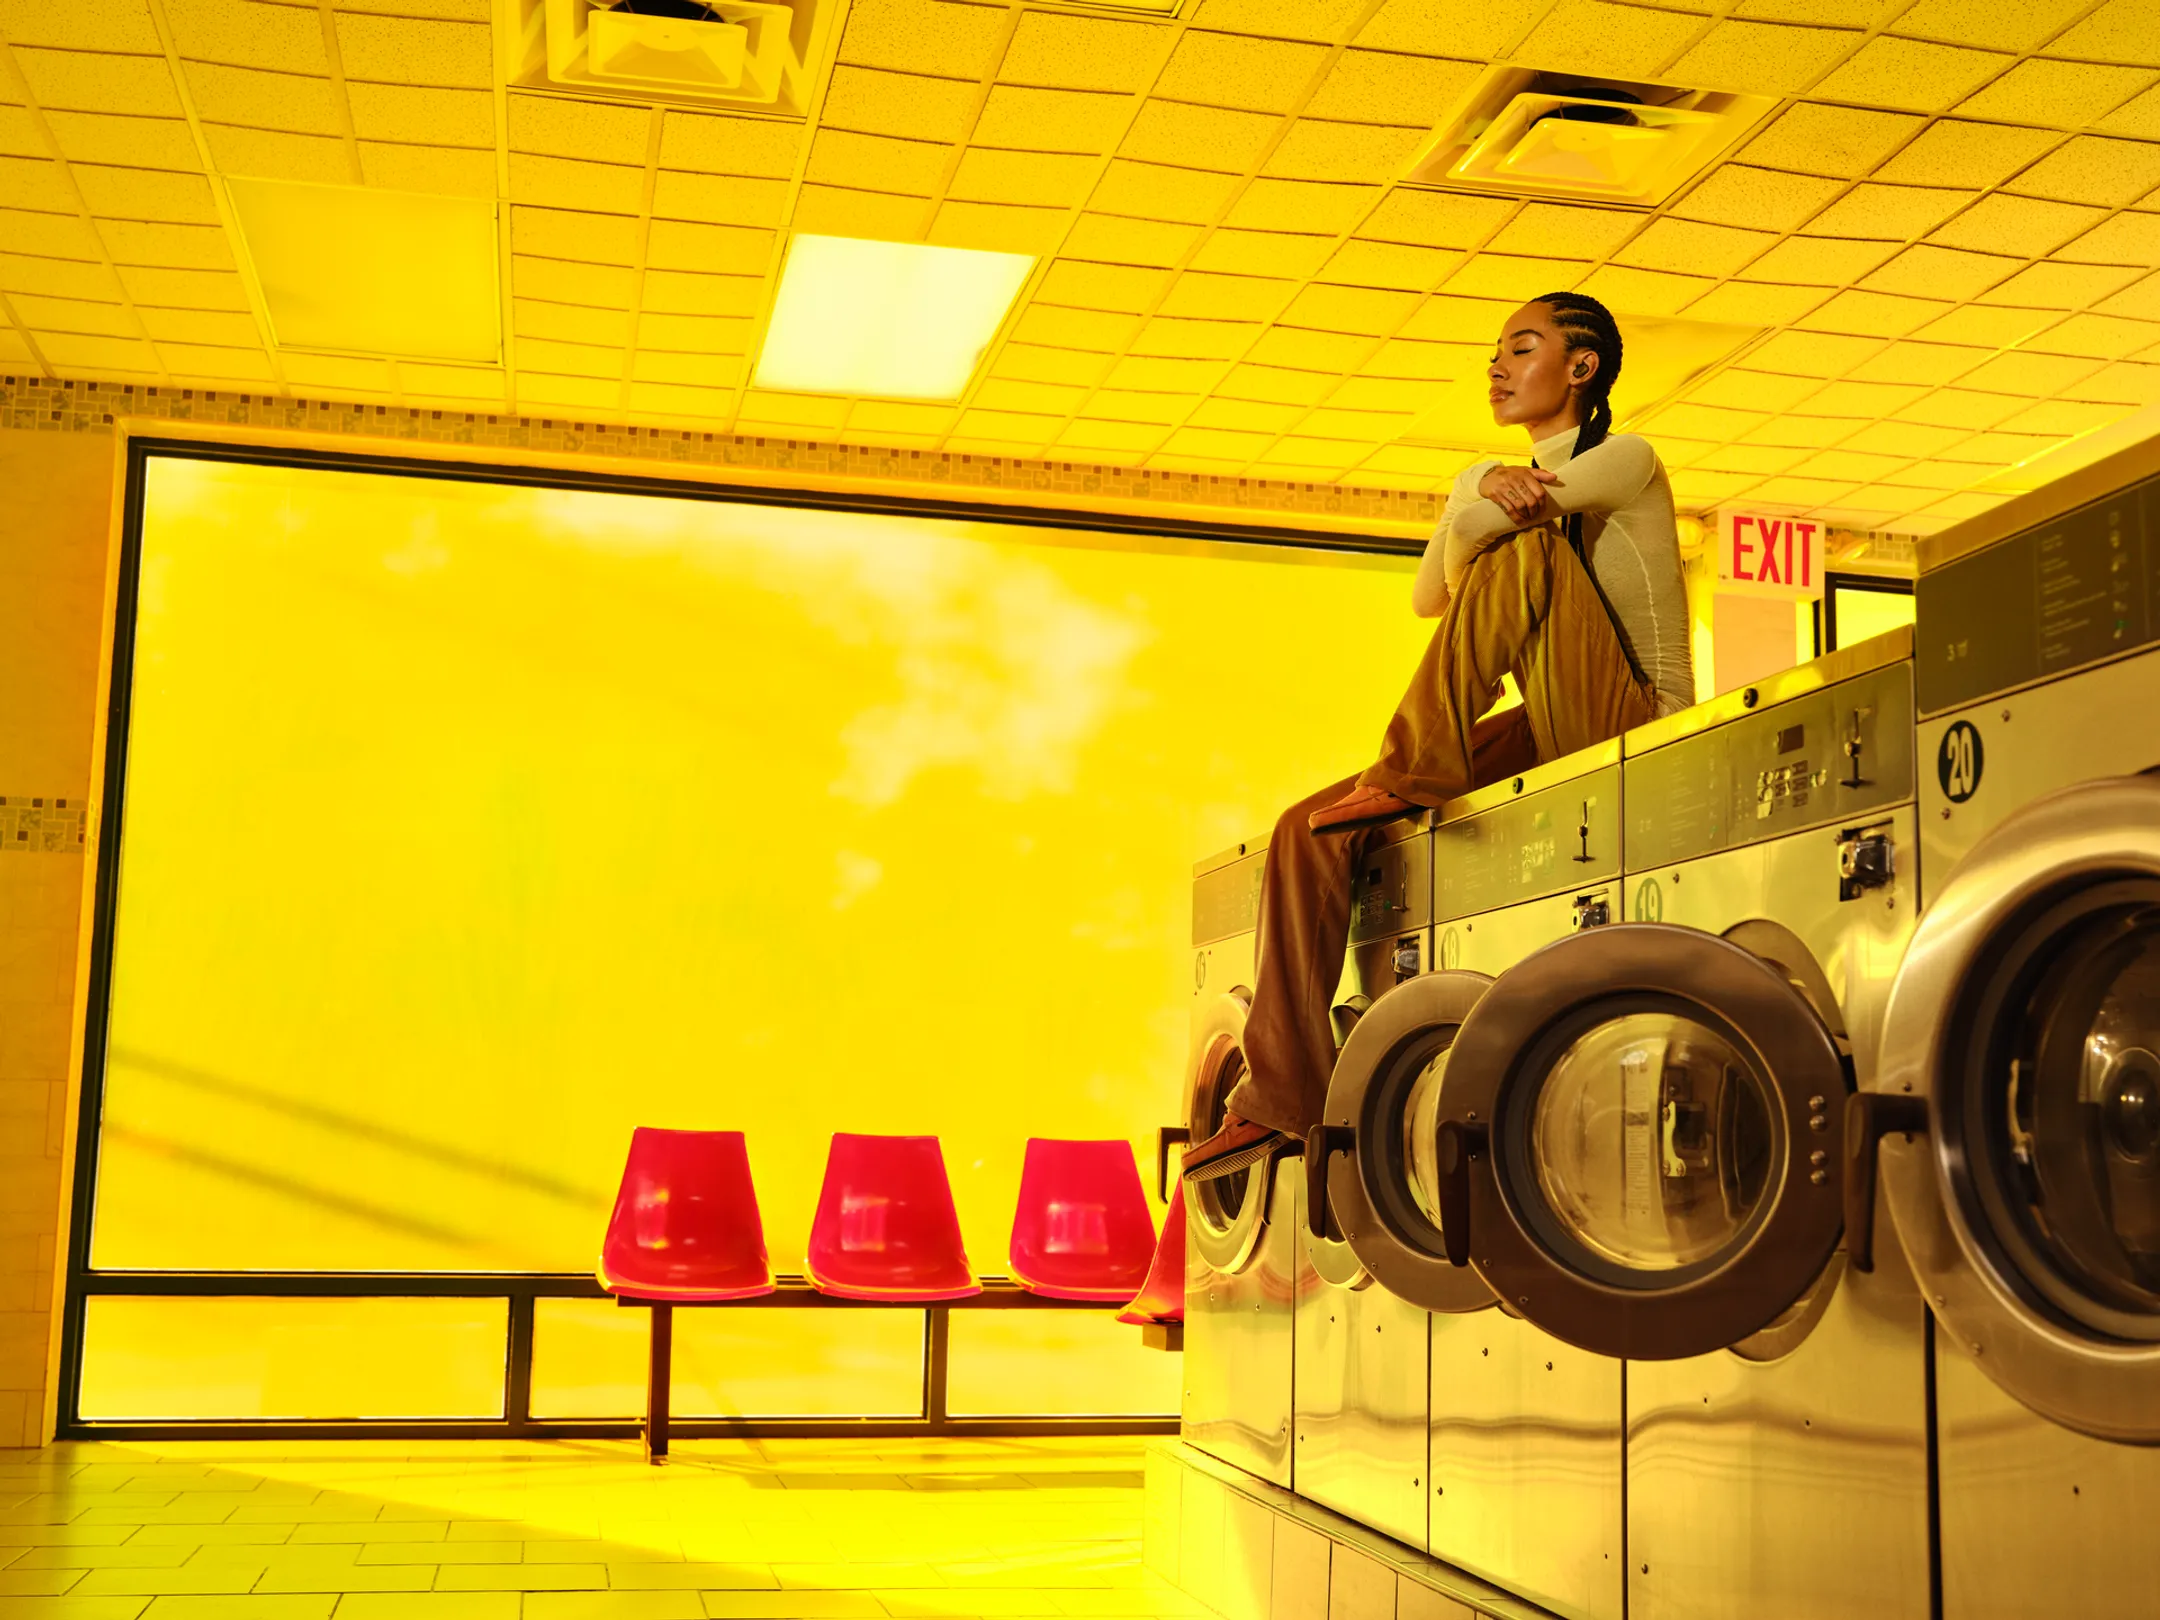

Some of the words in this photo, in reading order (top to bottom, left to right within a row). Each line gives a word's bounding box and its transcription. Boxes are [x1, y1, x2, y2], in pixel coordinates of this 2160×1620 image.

[1733, 516, 1816, 587] EXIT
[1947, 726, 1974, 796] 20
[1639, 883, 1658, 922] 19
[1443, 930, 1457, 969] 18
